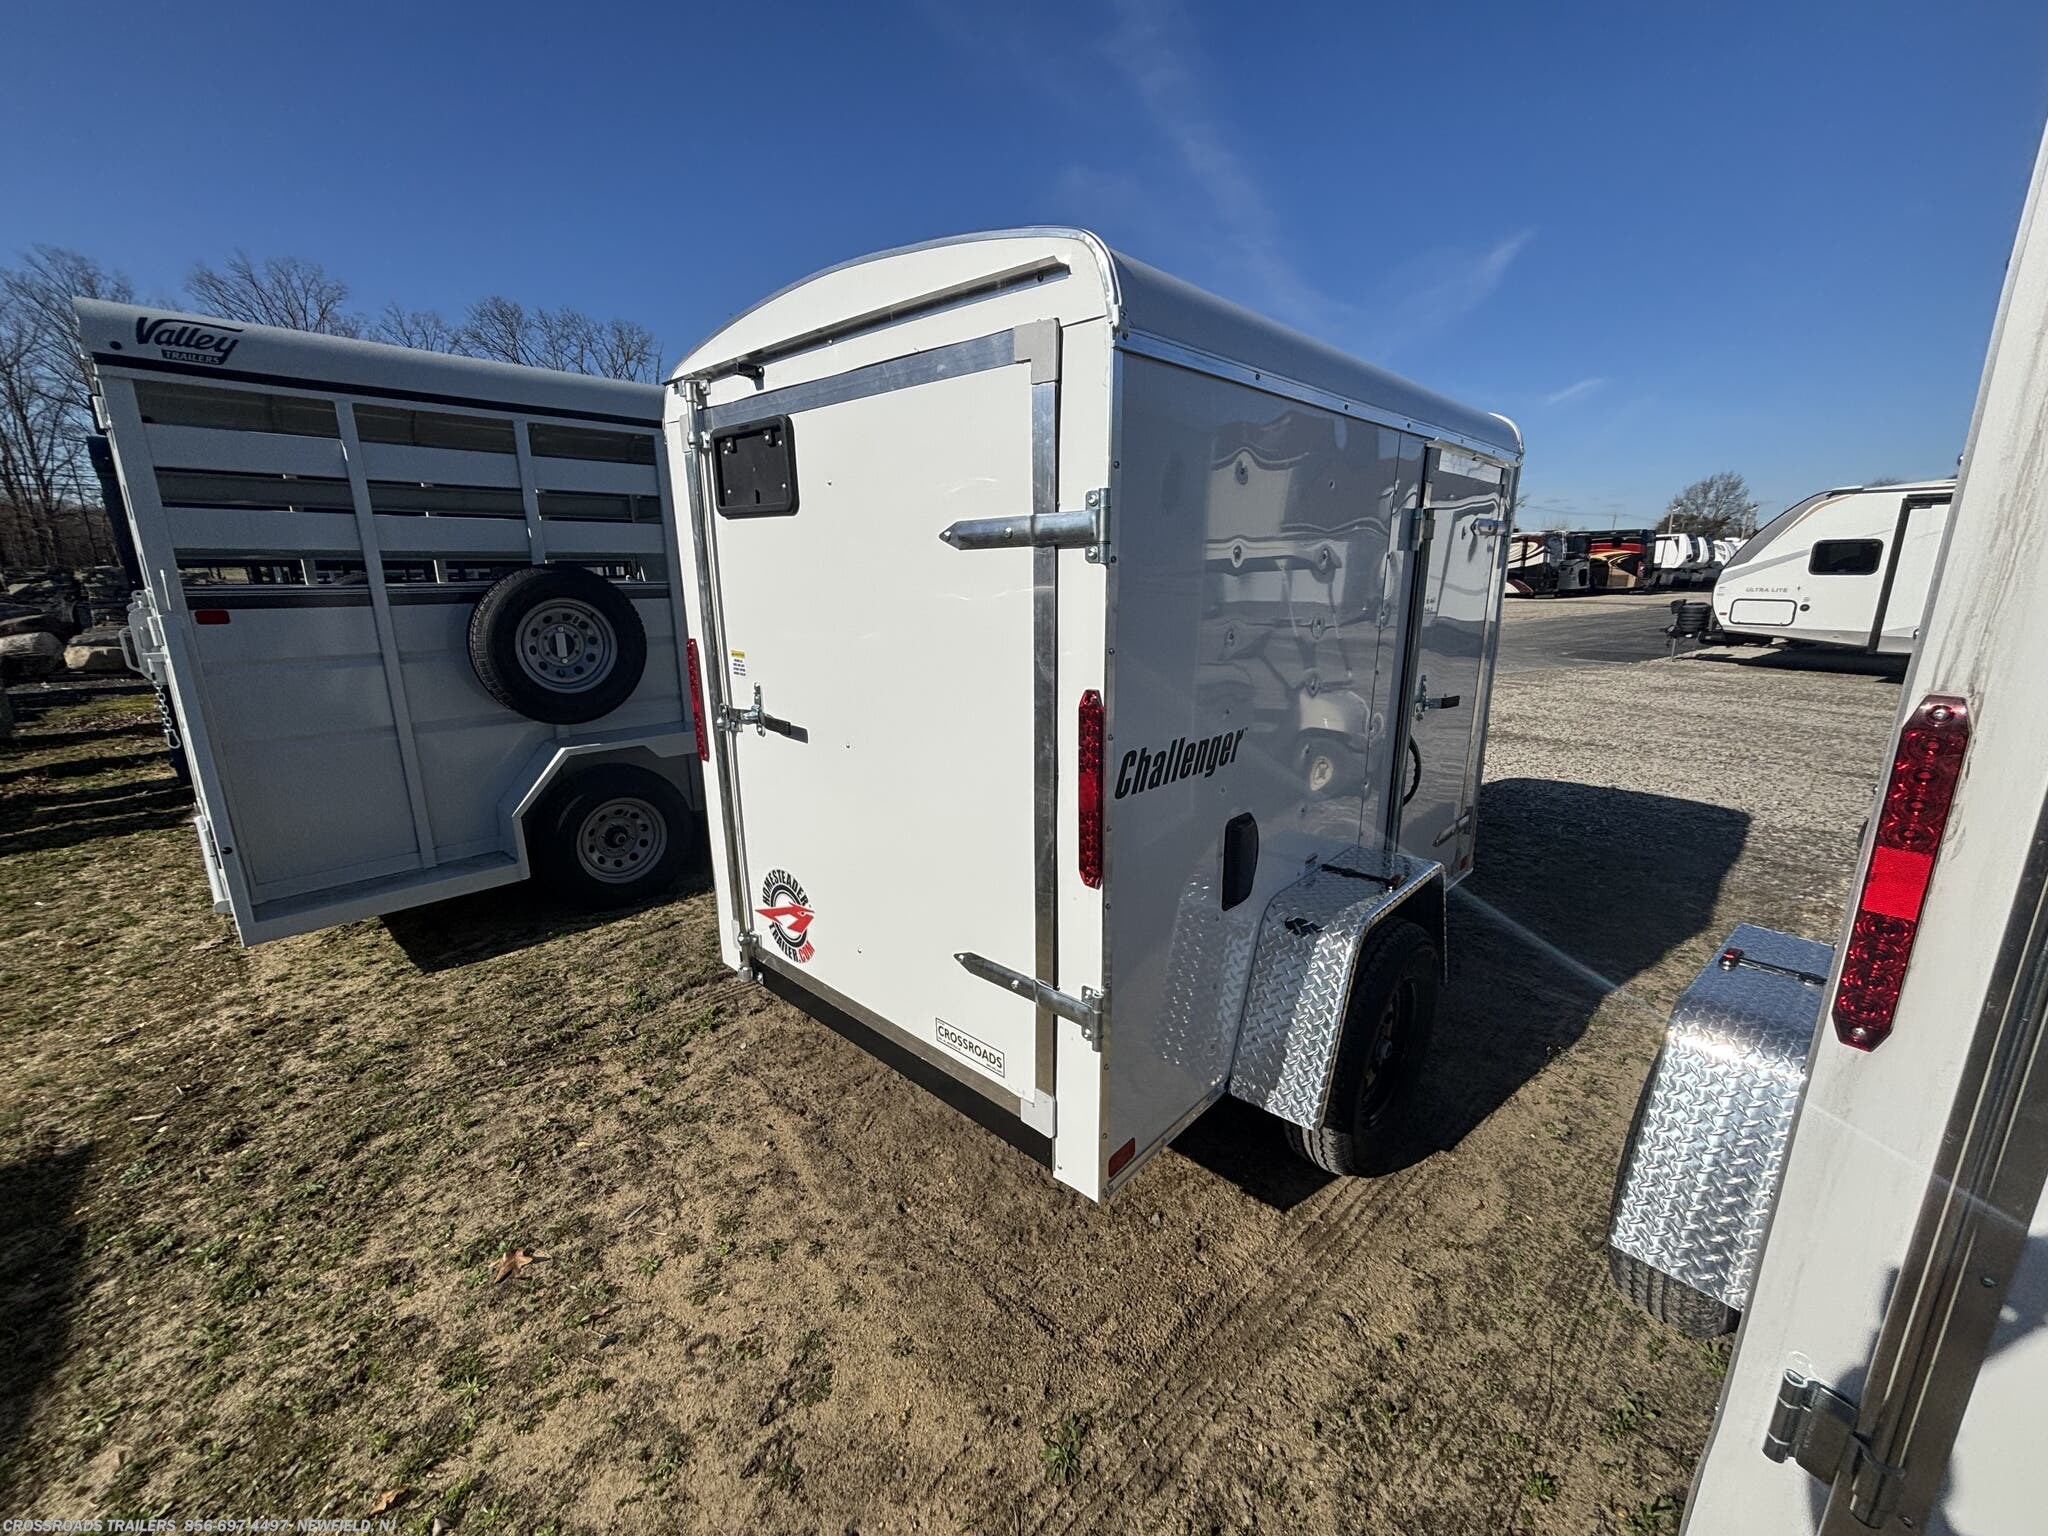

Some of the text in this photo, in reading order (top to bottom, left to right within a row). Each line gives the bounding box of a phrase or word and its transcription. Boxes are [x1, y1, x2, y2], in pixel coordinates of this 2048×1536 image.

[135, 316, 244, 356] Valley
[164, 350, 220, 365] TRAILERS
[1114, 728, 1244, 800] Challenger
[762, 869, 809, 907] HOMESTEADER
[938, 1025, 1003, 1069] CROSSROADS
